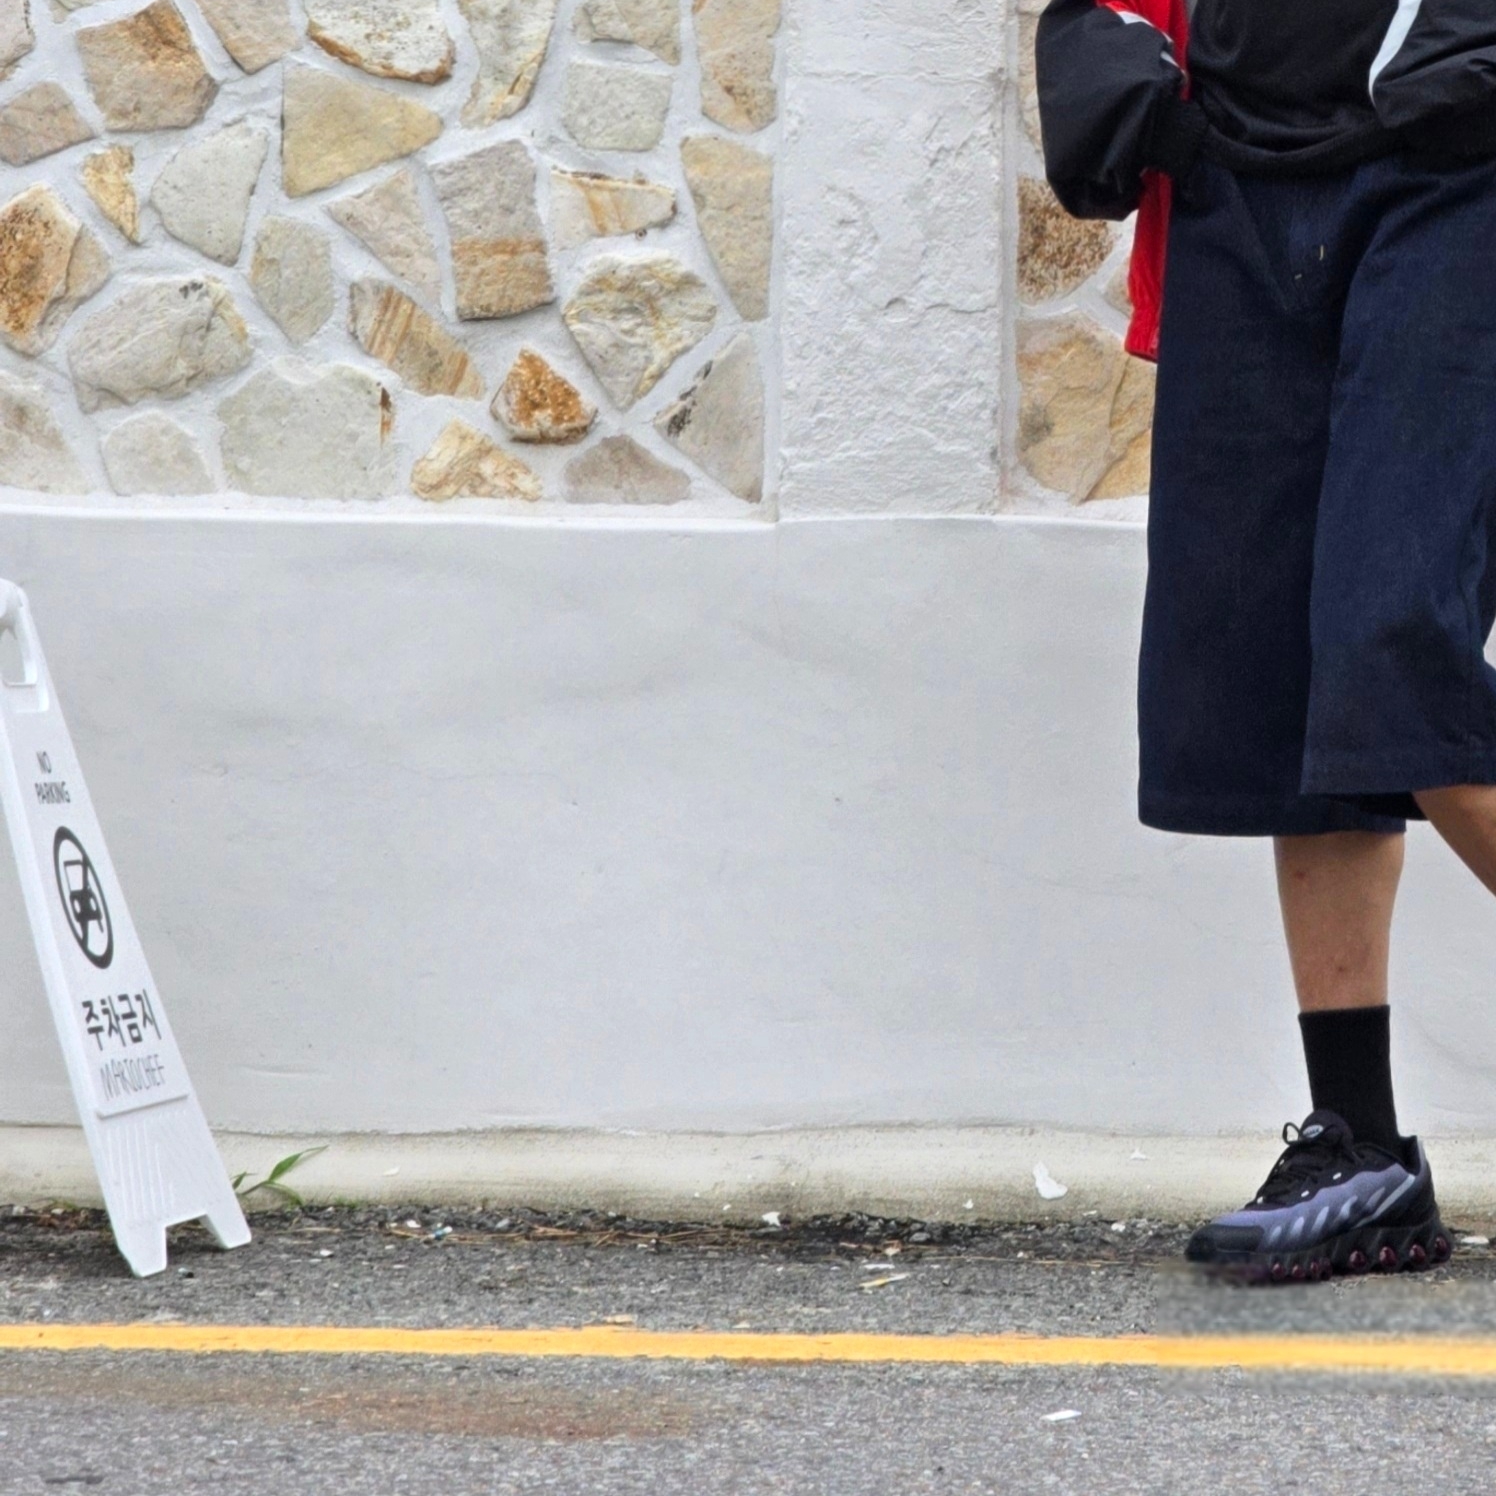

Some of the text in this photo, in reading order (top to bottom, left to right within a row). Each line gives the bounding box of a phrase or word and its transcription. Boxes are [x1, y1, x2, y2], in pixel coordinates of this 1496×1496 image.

[36, 751, 51, 774] NO
[35, 781, 70, 804] PARKING
[82, 989, 161, 1051] 주차금지
